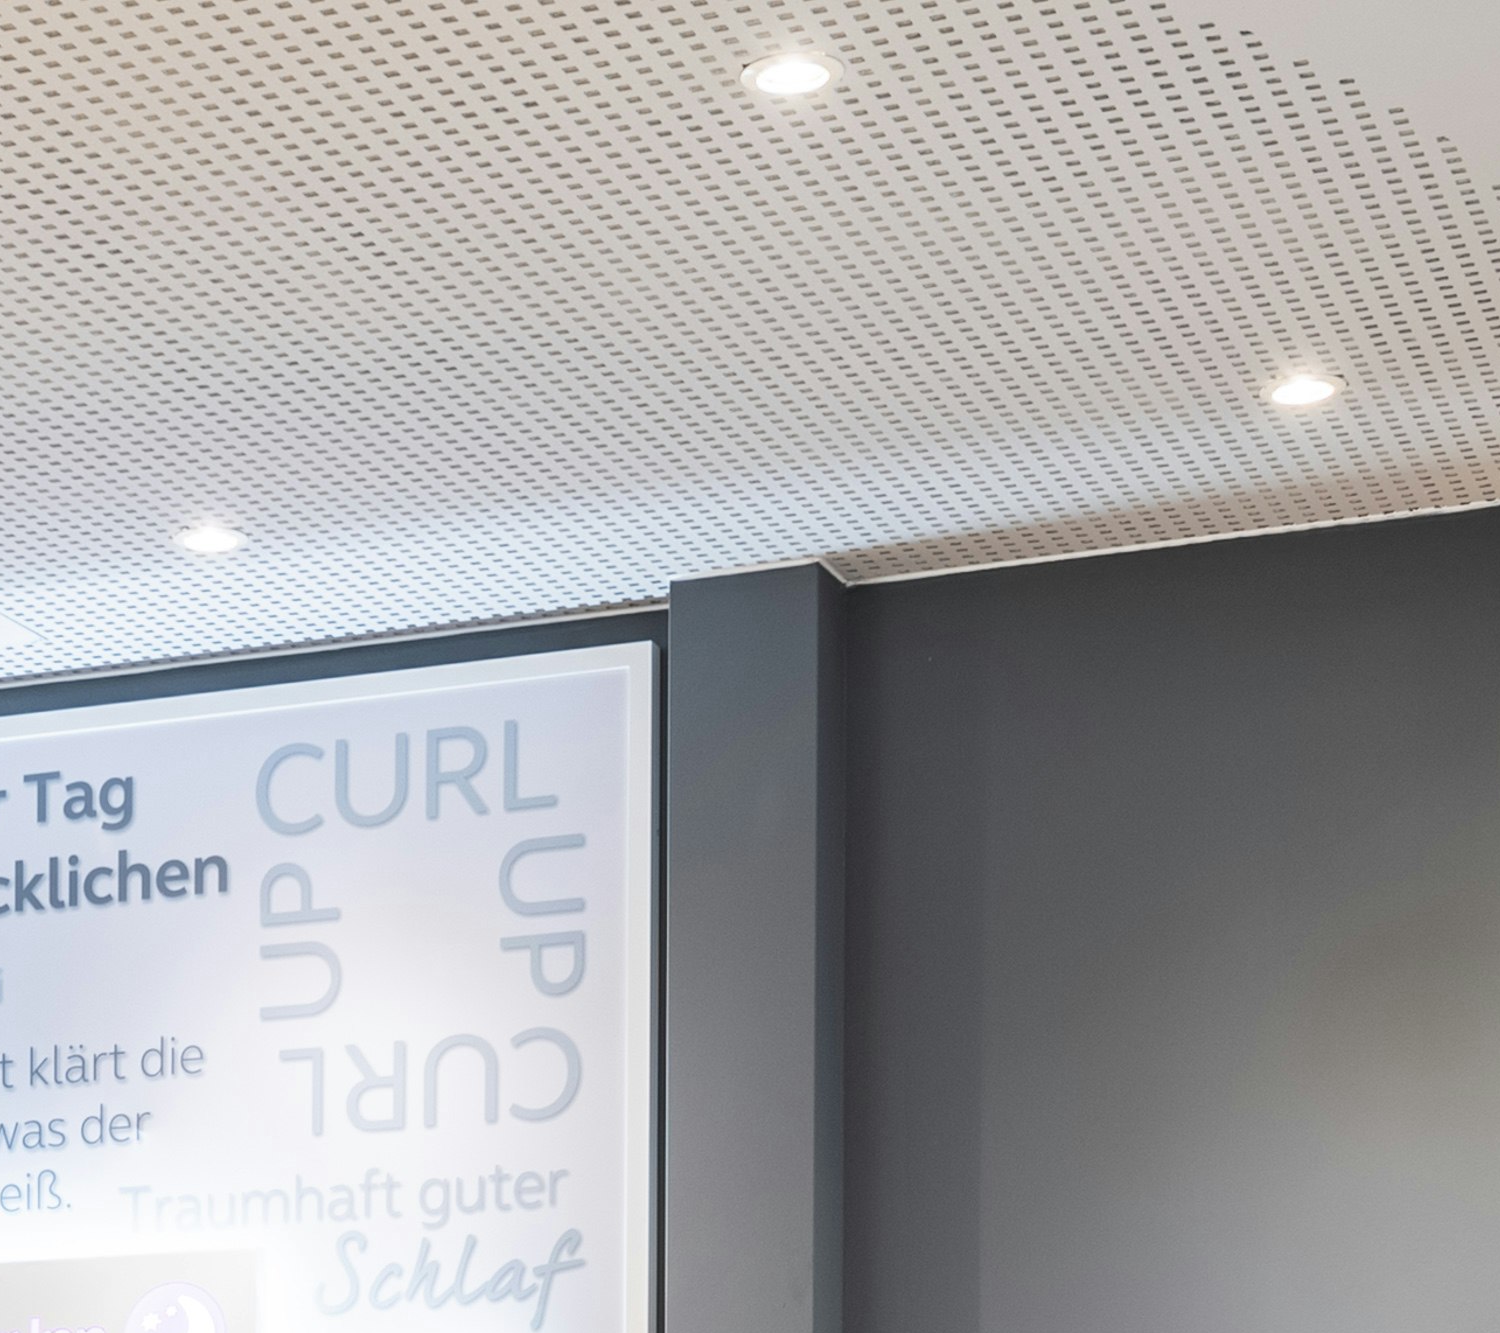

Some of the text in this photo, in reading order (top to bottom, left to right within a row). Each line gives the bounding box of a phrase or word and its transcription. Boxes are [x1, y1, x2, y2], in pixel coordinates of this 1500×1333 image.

[24, 768, 135, 835] Tag
[255, 719, 558, 837] CURL
[260, 861, 343, 1022] UP
[499, 833, 586, 997] UP
[27, 1042, 129, 1089] klärt
[138, 1037, 205, 1081] die
[279, 1026, 584, 1138] CURL
[79, 1105, 152, 1148] der
[118, 1165, 569, 1233] Traumhaft guter
[314, 1228, 586, 1332] Schlaf
